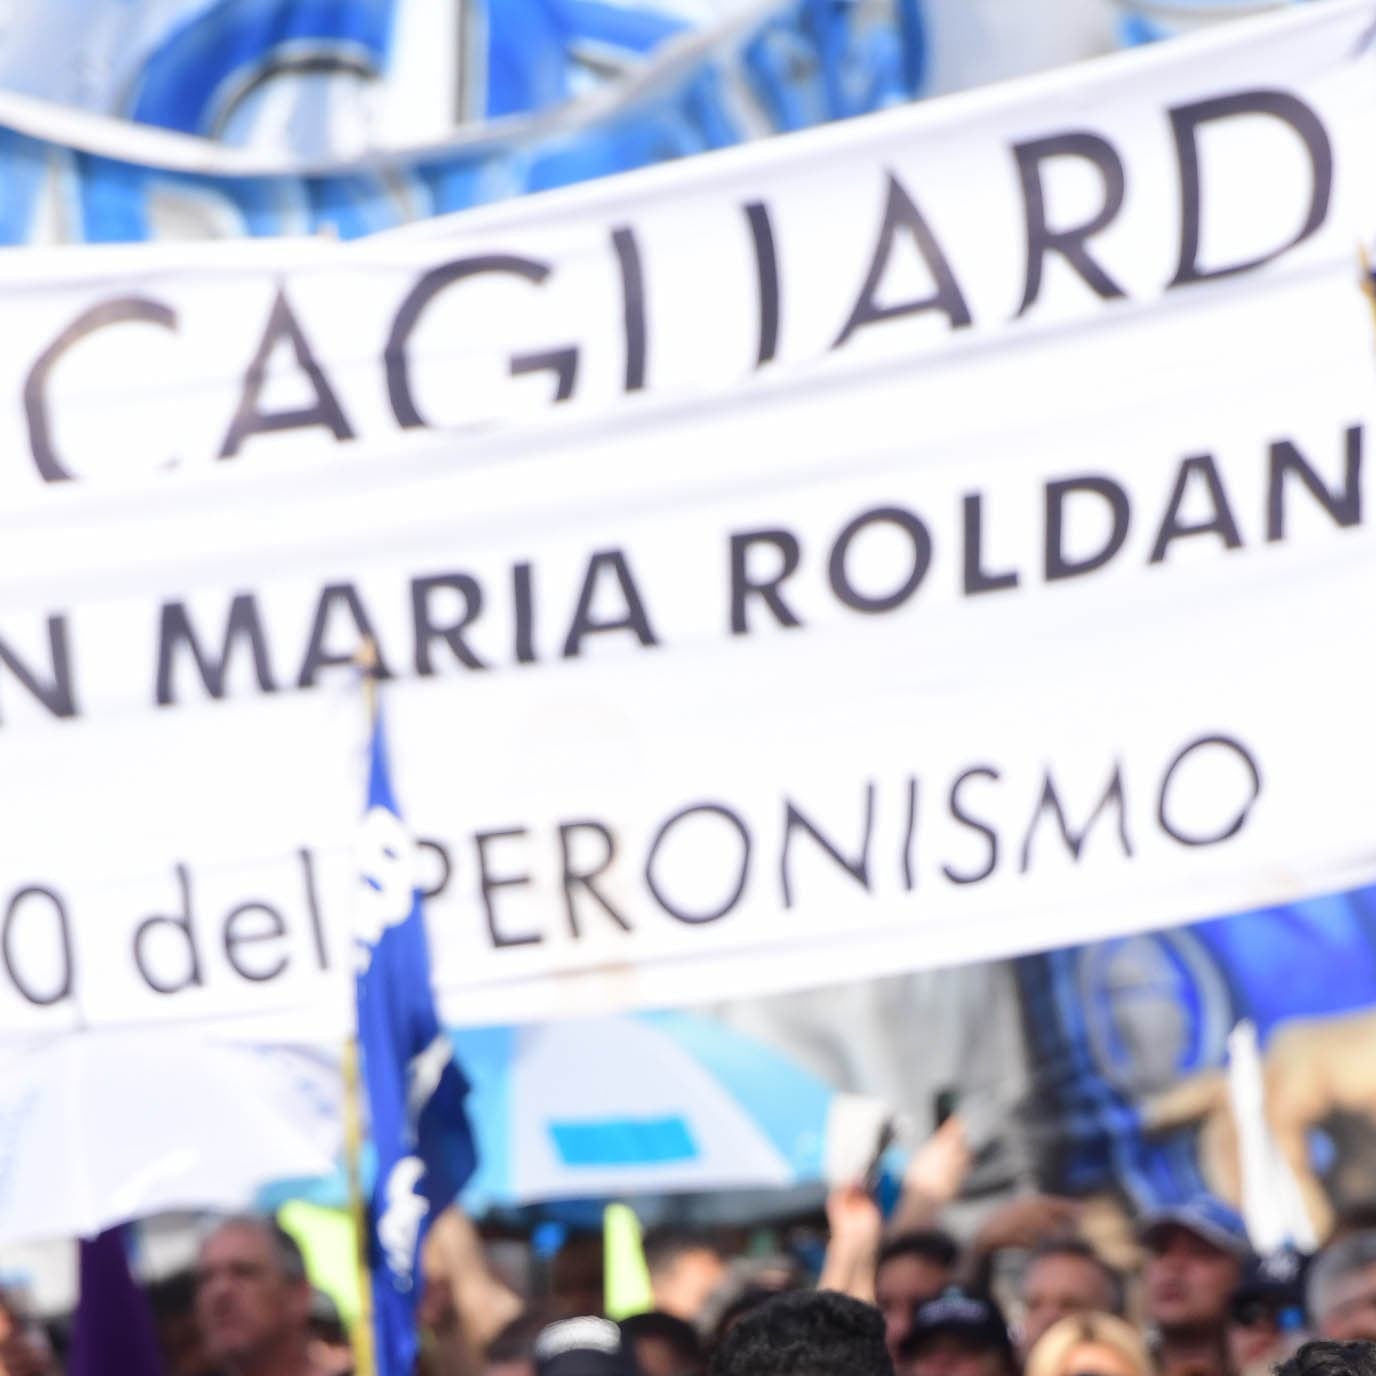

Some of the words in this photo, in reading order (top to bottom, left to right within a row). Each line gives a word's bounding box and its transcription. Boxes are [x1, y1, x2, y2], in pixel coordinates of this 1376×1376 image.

[154, 549, 660, 708] MARIA
[728, 425, 1364, 637] ROLDAN
[132, 848, 332, 995] del
